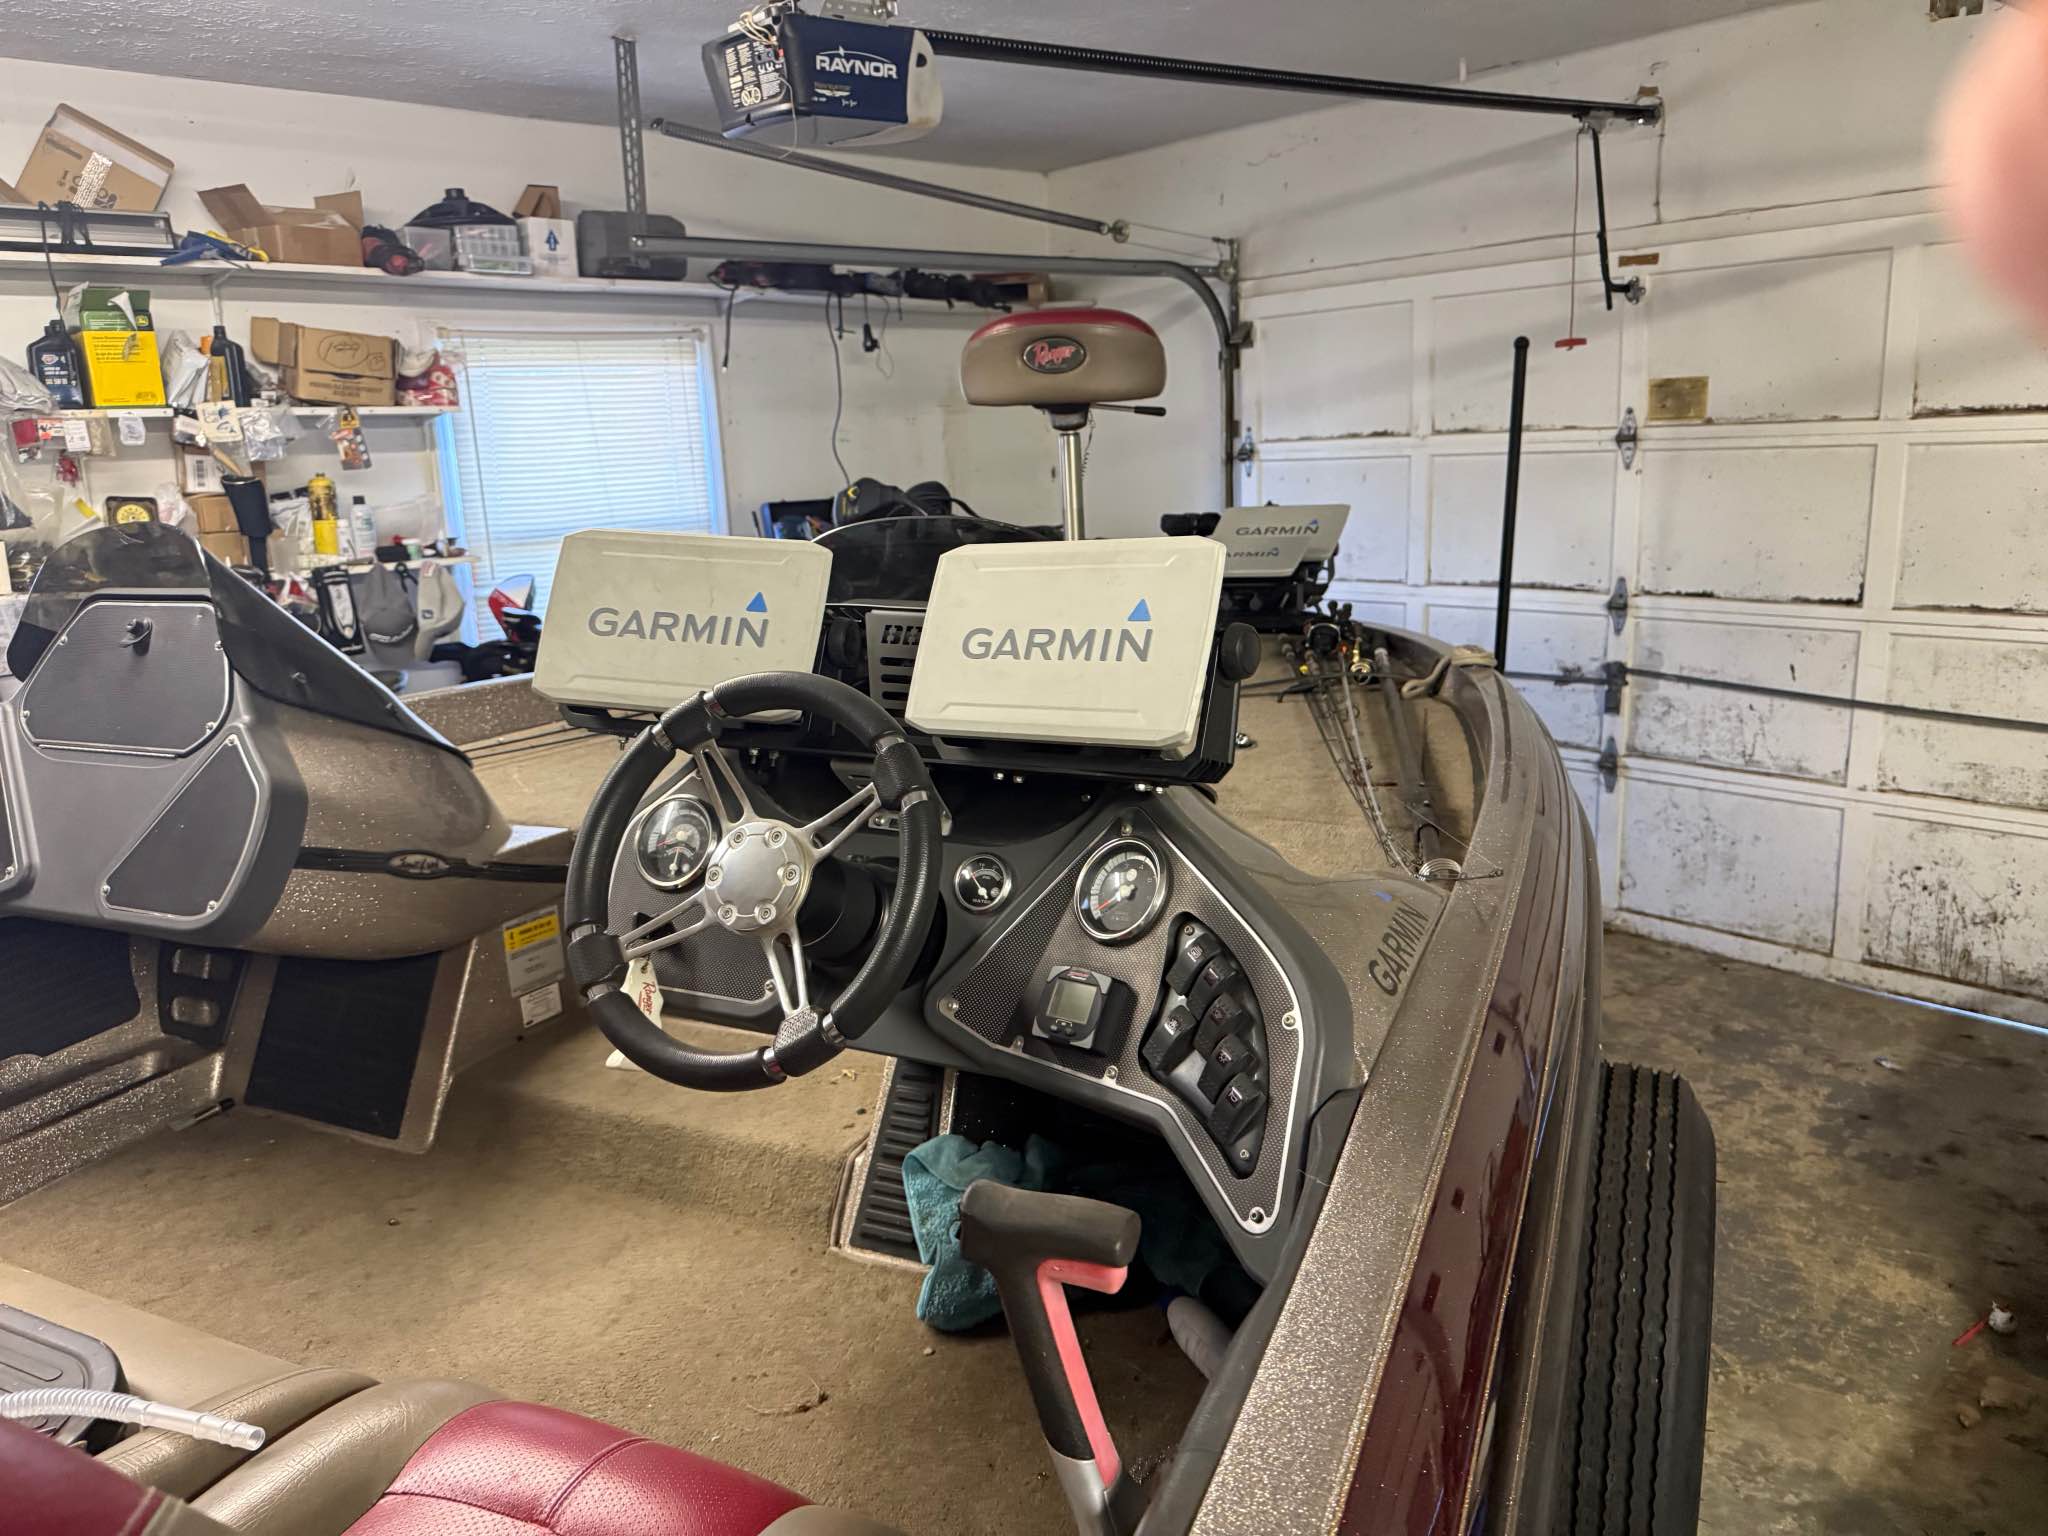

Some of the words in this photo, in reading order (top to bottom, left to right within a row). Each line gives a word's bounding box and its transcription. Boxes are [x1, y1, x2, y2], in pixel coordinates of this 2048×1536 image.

[815, 54, 898, 79] RAYNOR
[1235, 525, 1319, 536] GARMIN
[1226, 550, 1280, 558] ARMIN
[588, 607, 769, 648] GARMIN
[962, 627, 1153, 662] GARMIN
[1369, 900, 1429, 997] GARMIN
[641, 981, 657, 1015] Ranger
